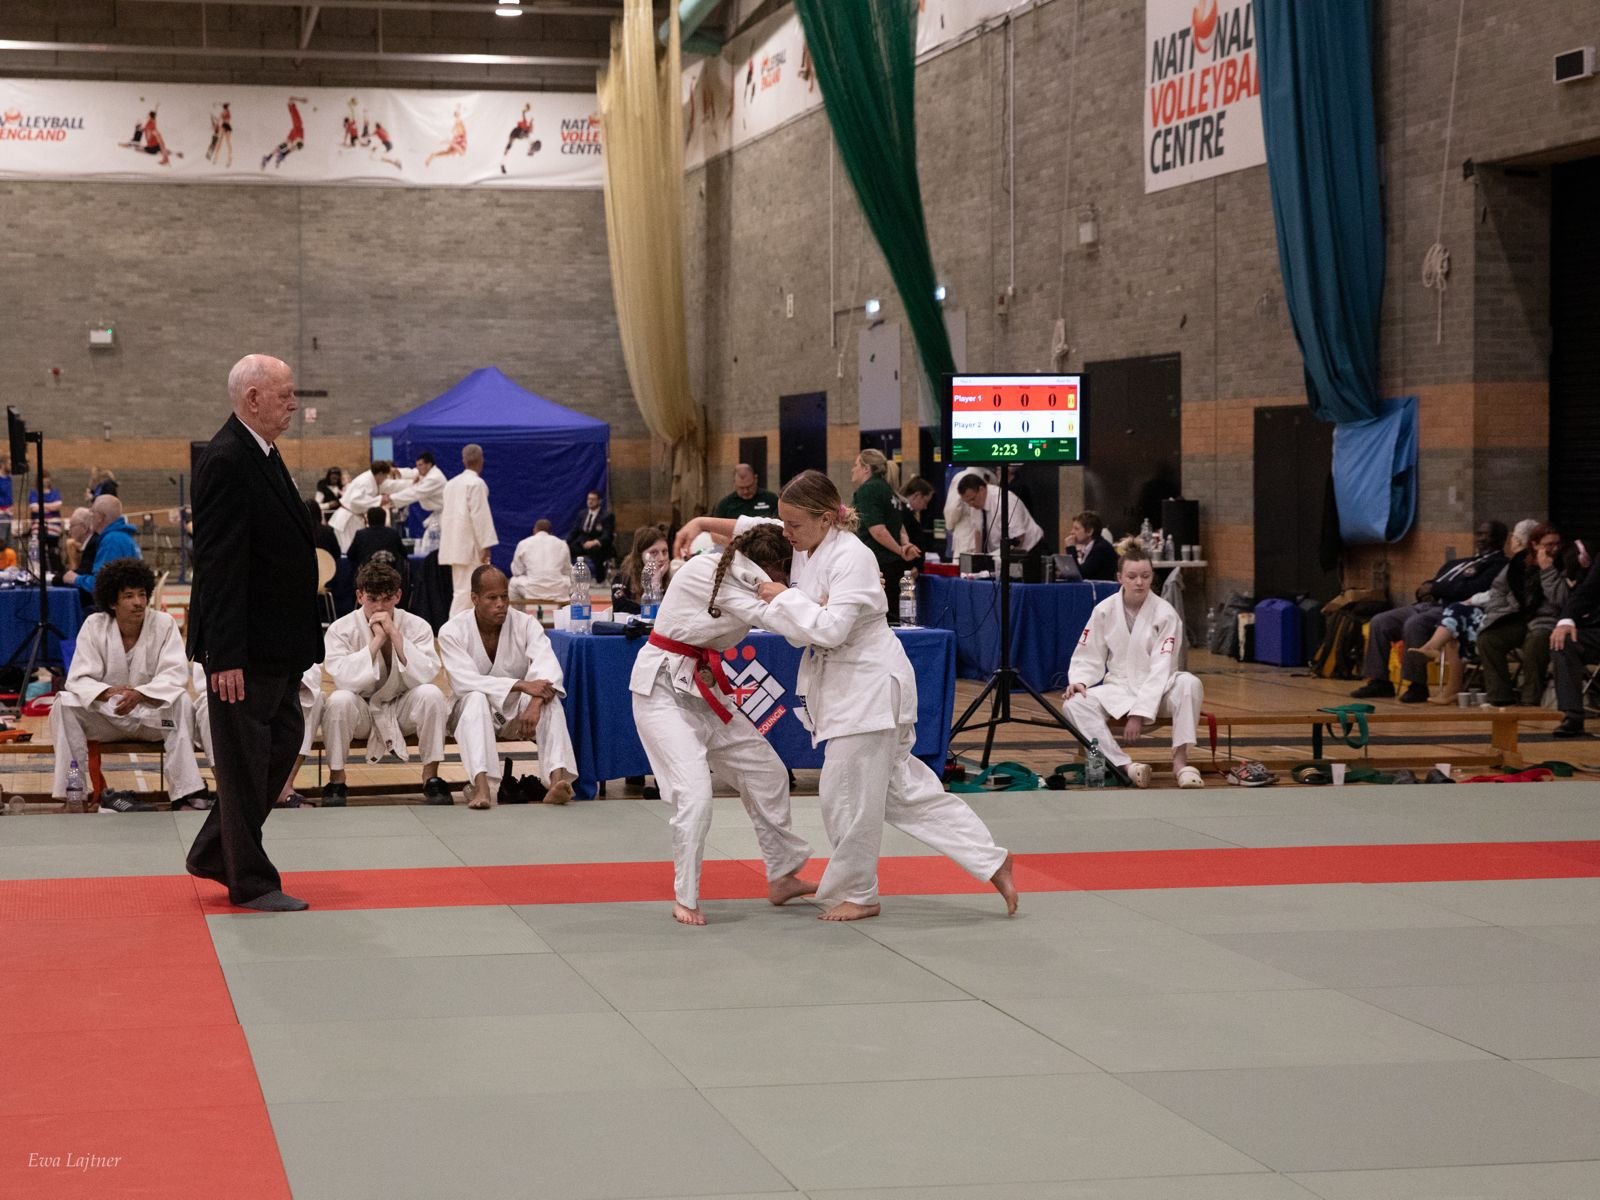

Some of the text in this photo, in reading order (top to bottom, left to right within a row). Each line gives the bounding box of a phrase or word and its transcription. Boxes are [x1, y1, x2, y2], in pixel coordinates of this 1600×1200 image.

[1151, 52, 1261, 129] VOLLEYBA
[0, 128, 67, 142] ENGLAND
[561, 131, 600, 144] VOLLE
[561, 143, 603, 155] CENTR
[1151, 110, 1227, 175] CENTRE
[954, 394, 976, 404] Player
[977, 394, 982, 402] 1
[993, 393, 1002, 407] 0
[1021, 393, 1030, 407] 0
[1048, 393, 1057, 407] 0
[954, 421, 975, 430] Player
[993, 420, 1002, 433] 0
[1021, 420, 1030, 433] 0
[1050, 420, 1055, 433] 1
[991, 444, 1018, 456] 2:23
[1034, 448, 1041, 457] 0
[758, 706, 787, 735] COUNCIL
